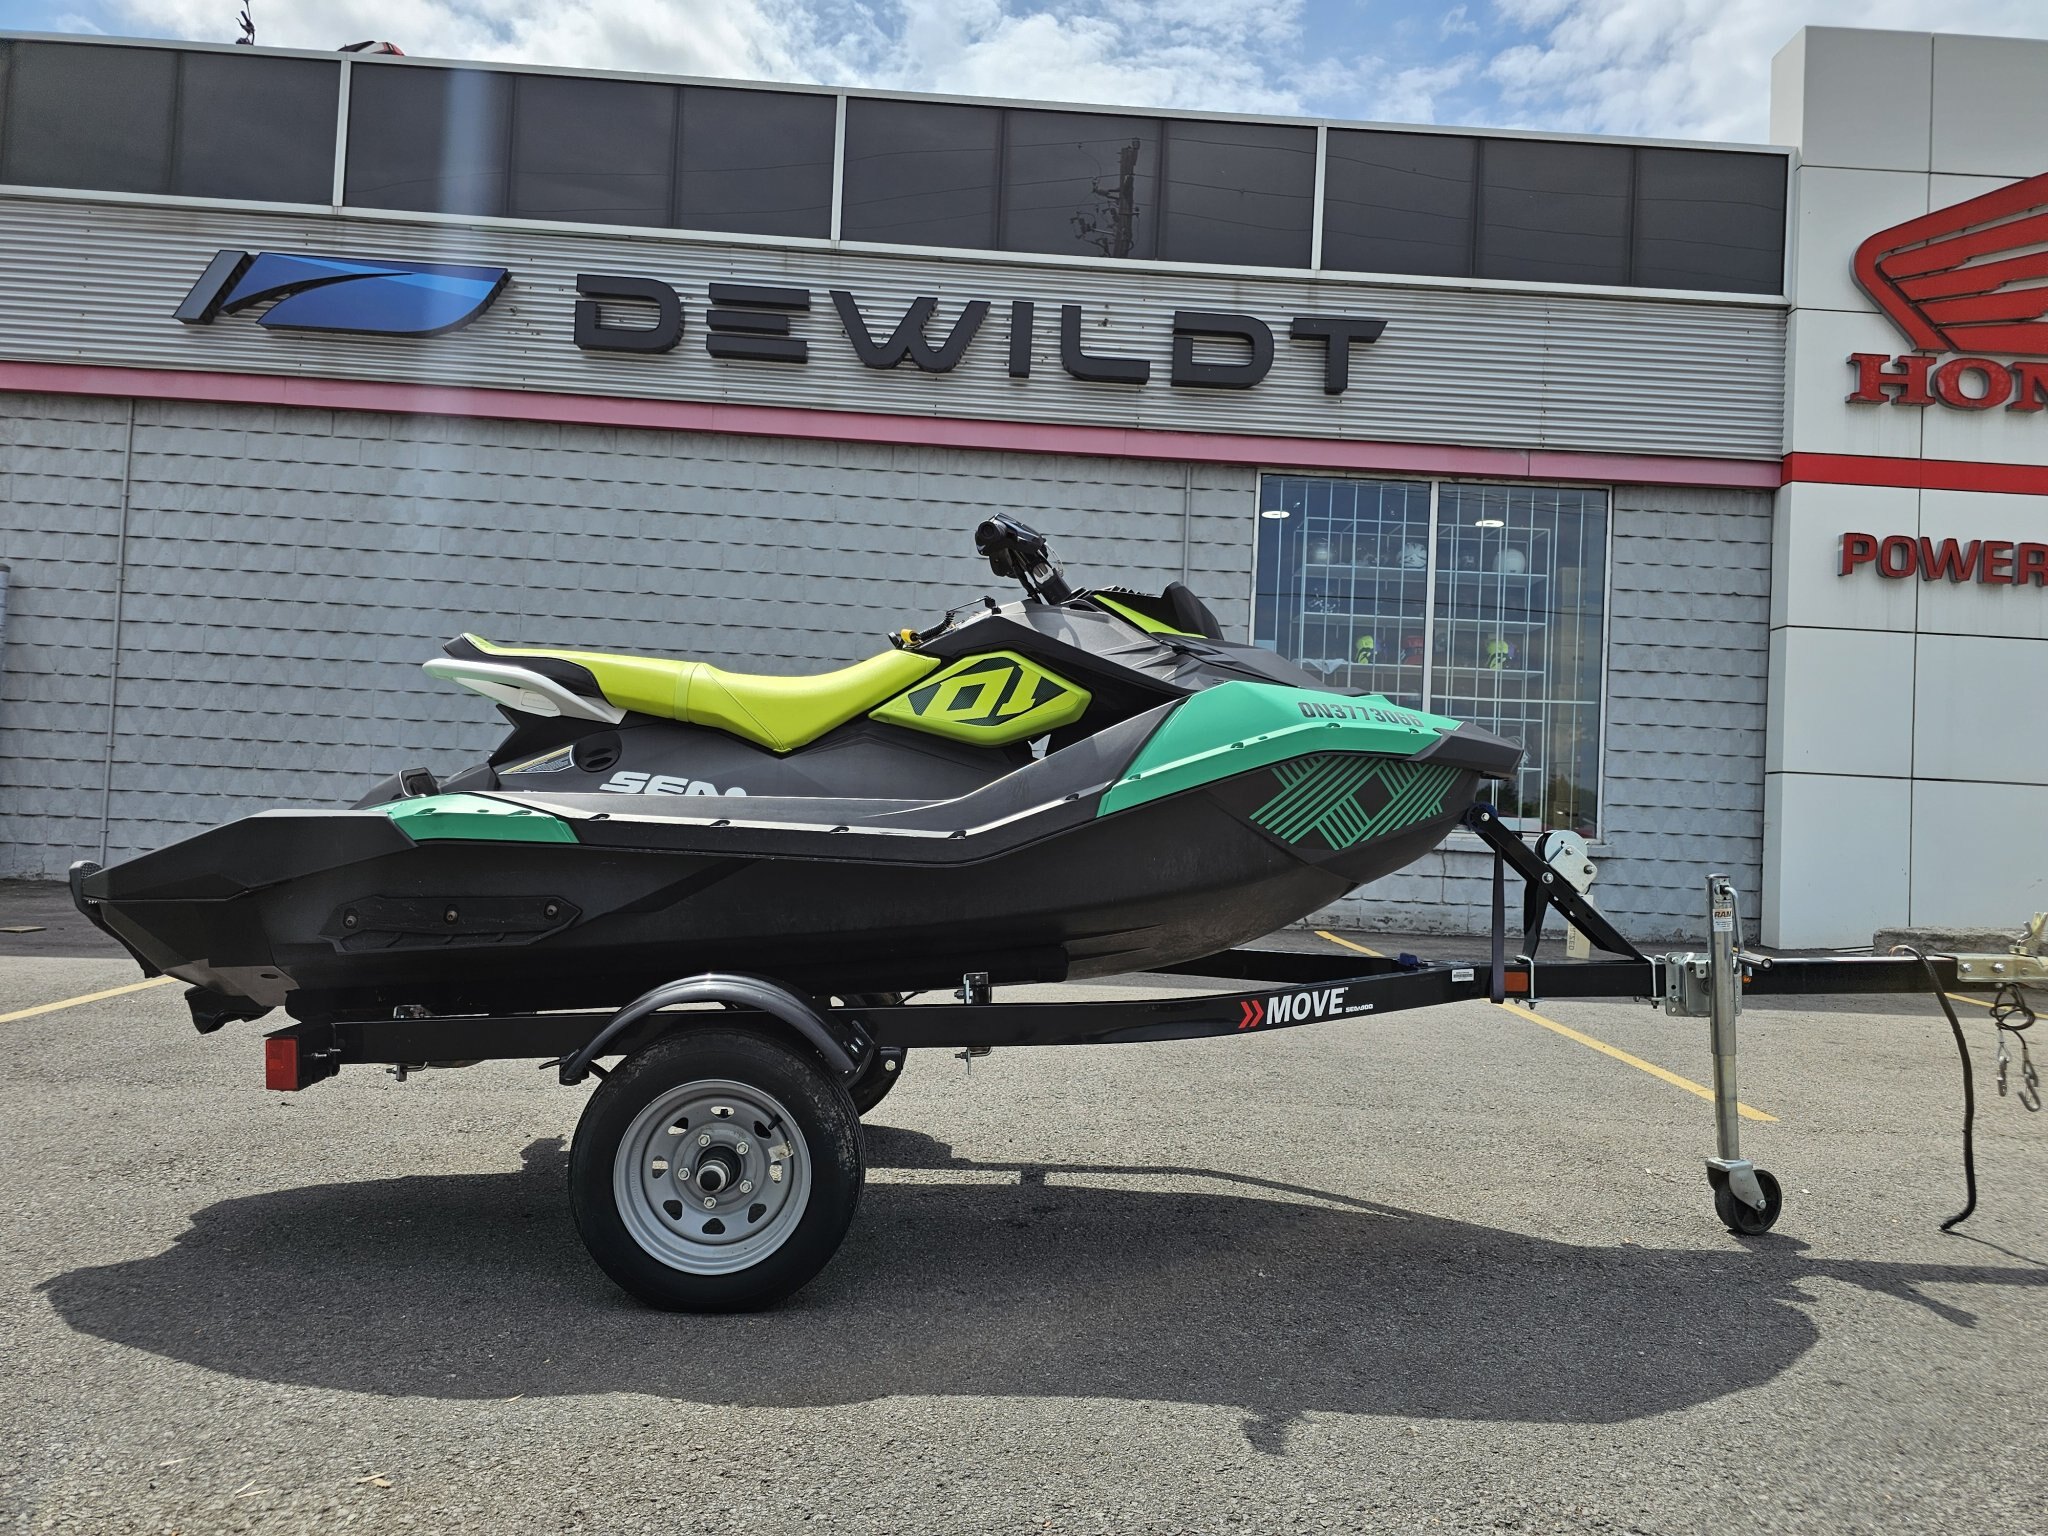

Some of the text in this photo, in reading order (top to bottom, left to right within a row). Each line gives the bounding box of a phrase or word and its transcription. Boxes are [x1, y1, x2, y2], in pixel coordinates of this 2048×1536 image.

[573, 273, 1388, 395] DEWILDT
[1838, 532, 2048, 587] POWER
[1267, 987, 1345, 1025] MOVE
